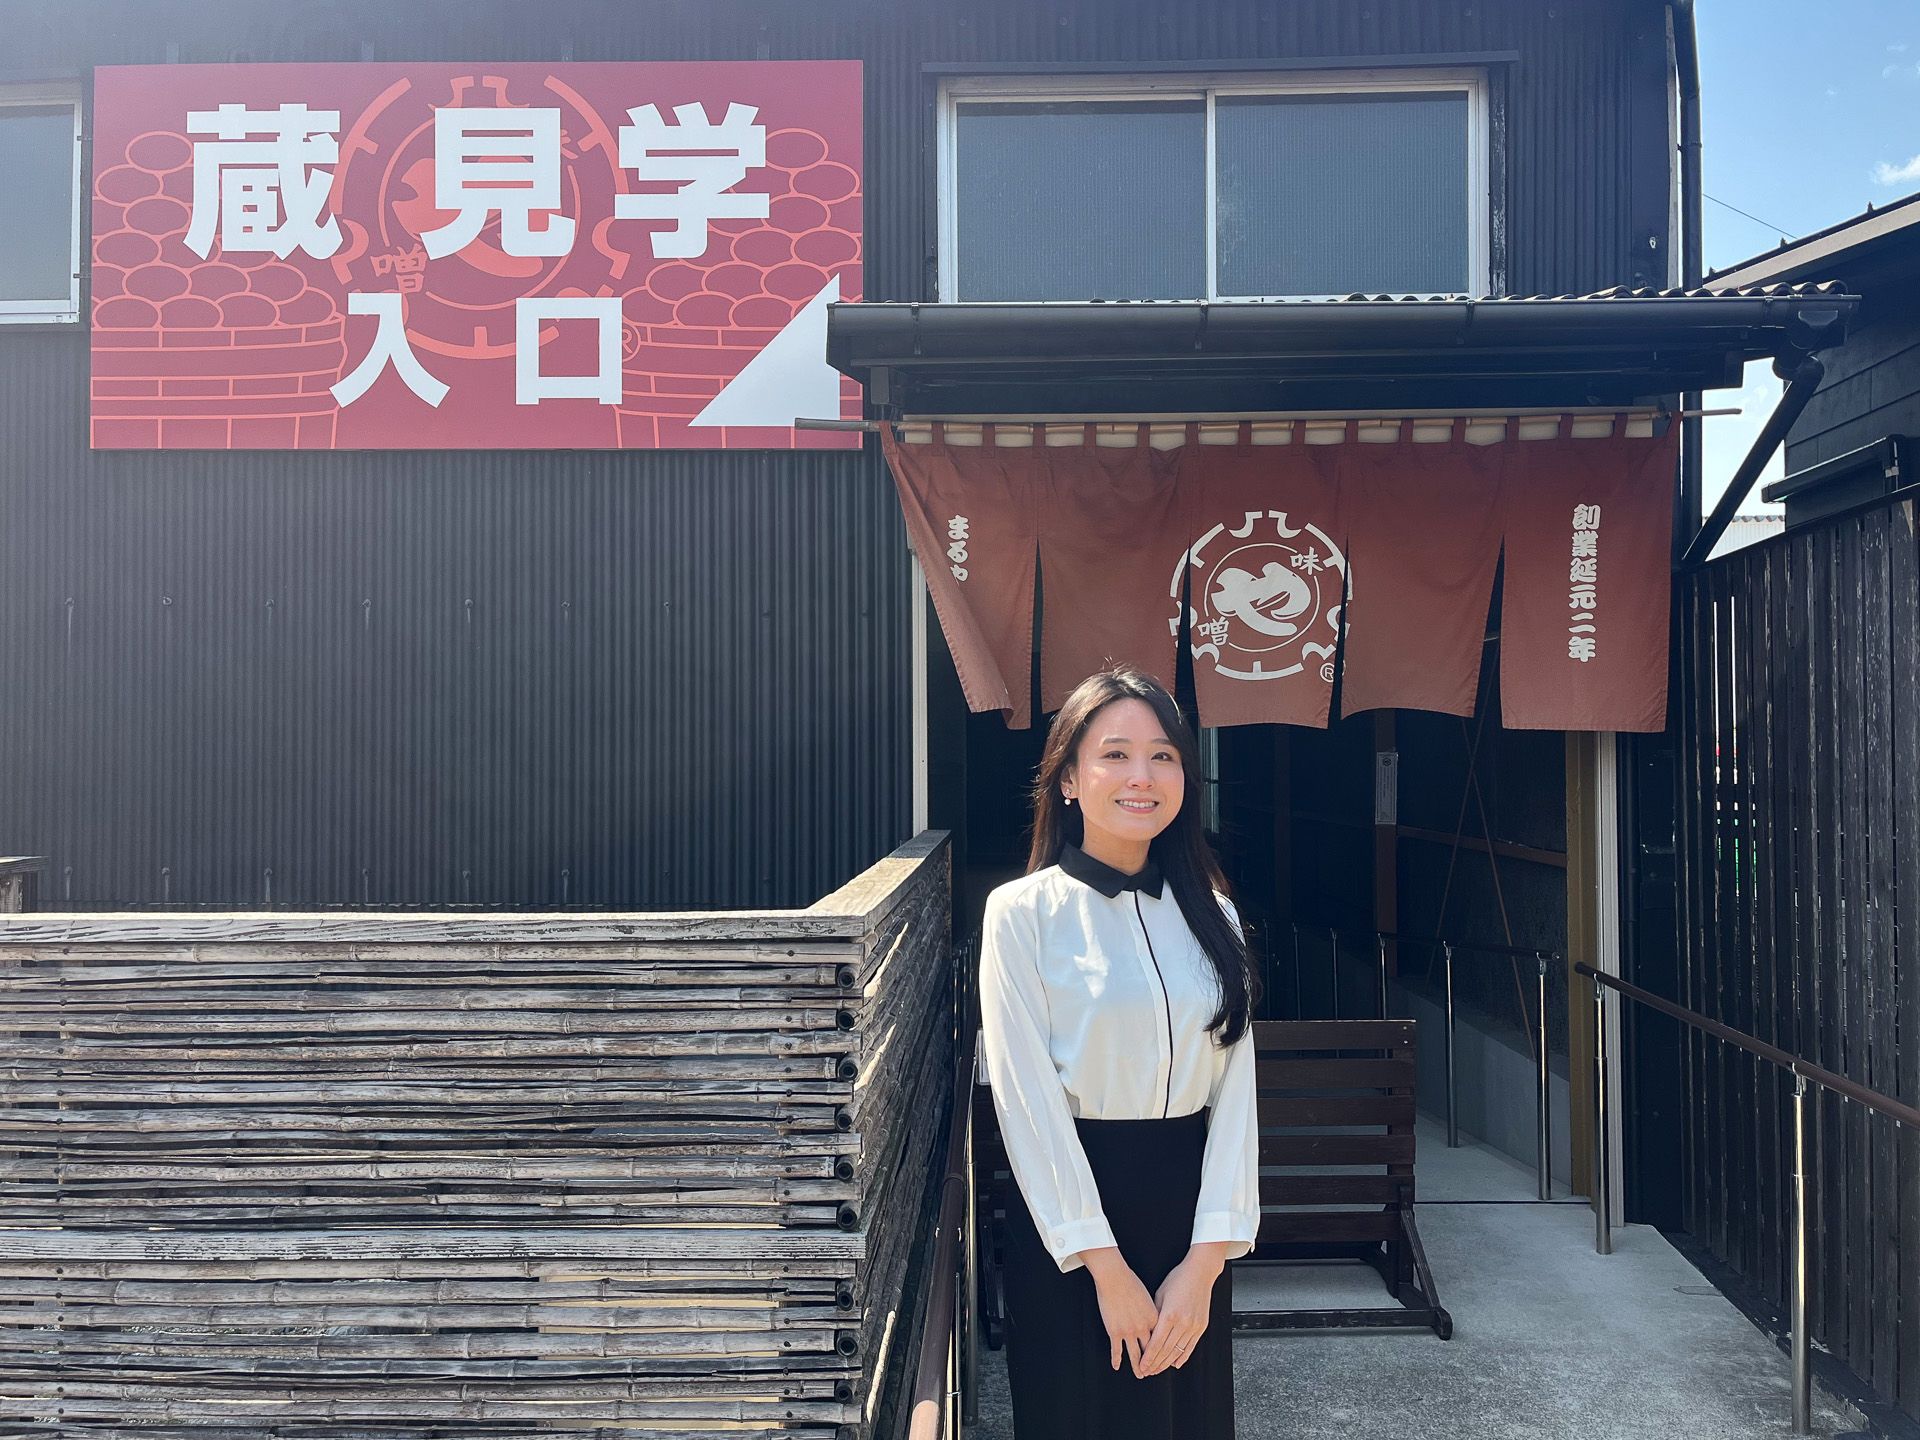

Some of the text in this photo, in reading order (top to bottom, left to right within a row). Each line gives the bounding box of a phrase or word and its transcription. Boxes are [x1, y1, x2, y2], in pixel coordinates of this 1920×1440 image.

[182, 102, 770, 260] 蔵見学
[329, 292, 623, 408] 入口
[1568, 503, 1601, 662] 創業延元二年
